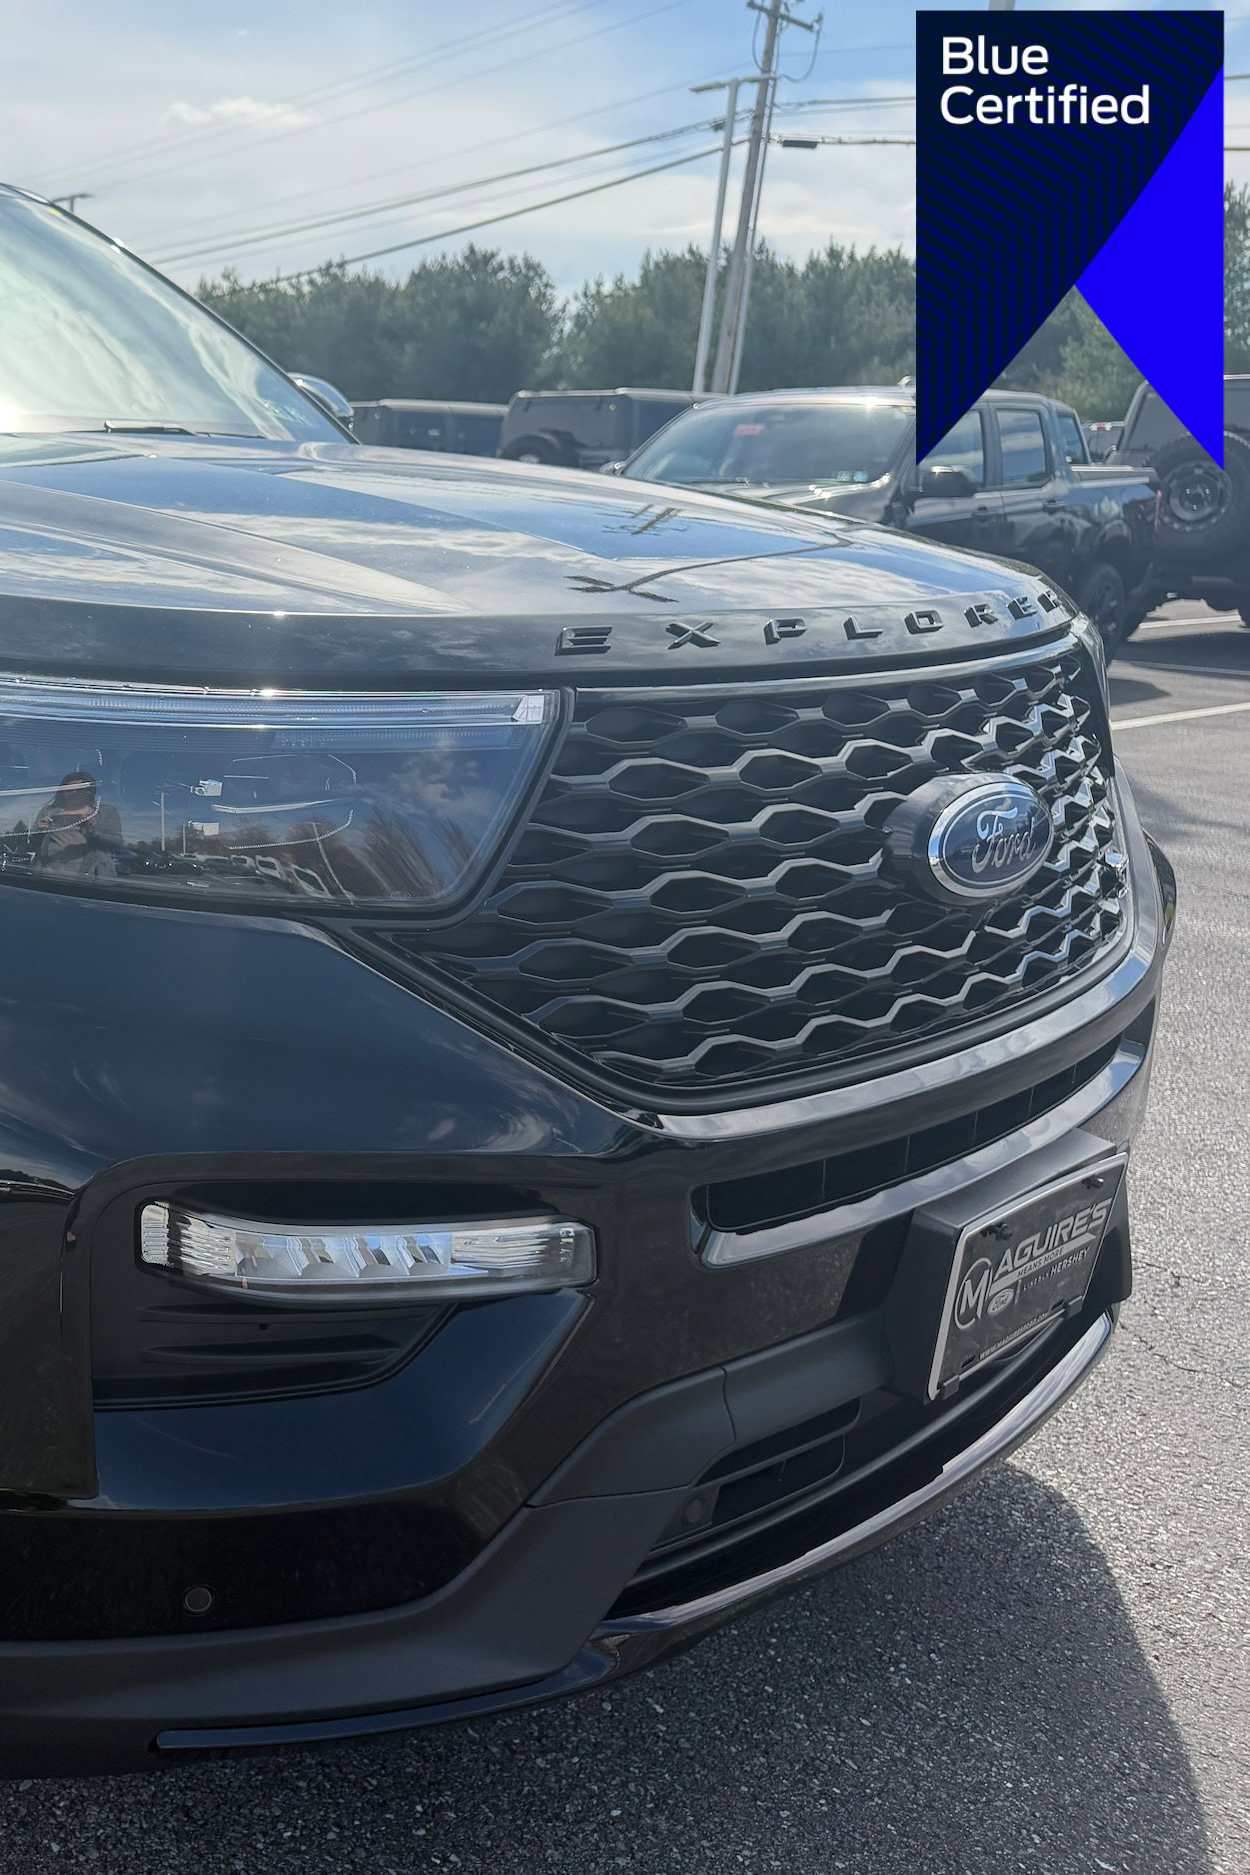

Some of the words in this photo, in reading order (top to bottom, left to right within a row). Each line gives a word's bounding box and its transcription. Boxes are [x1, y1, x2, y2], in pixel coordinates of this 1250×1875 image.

[555, 588, 1061, 656] EXPLORER
[971, 805, 1036, 874] Ford
[1017, 1260, 1042, 1277] MEANS
[1043, 1247, 1064, 1265] MORE
[1050, 1246, 1090, 1277] HERSHEY
